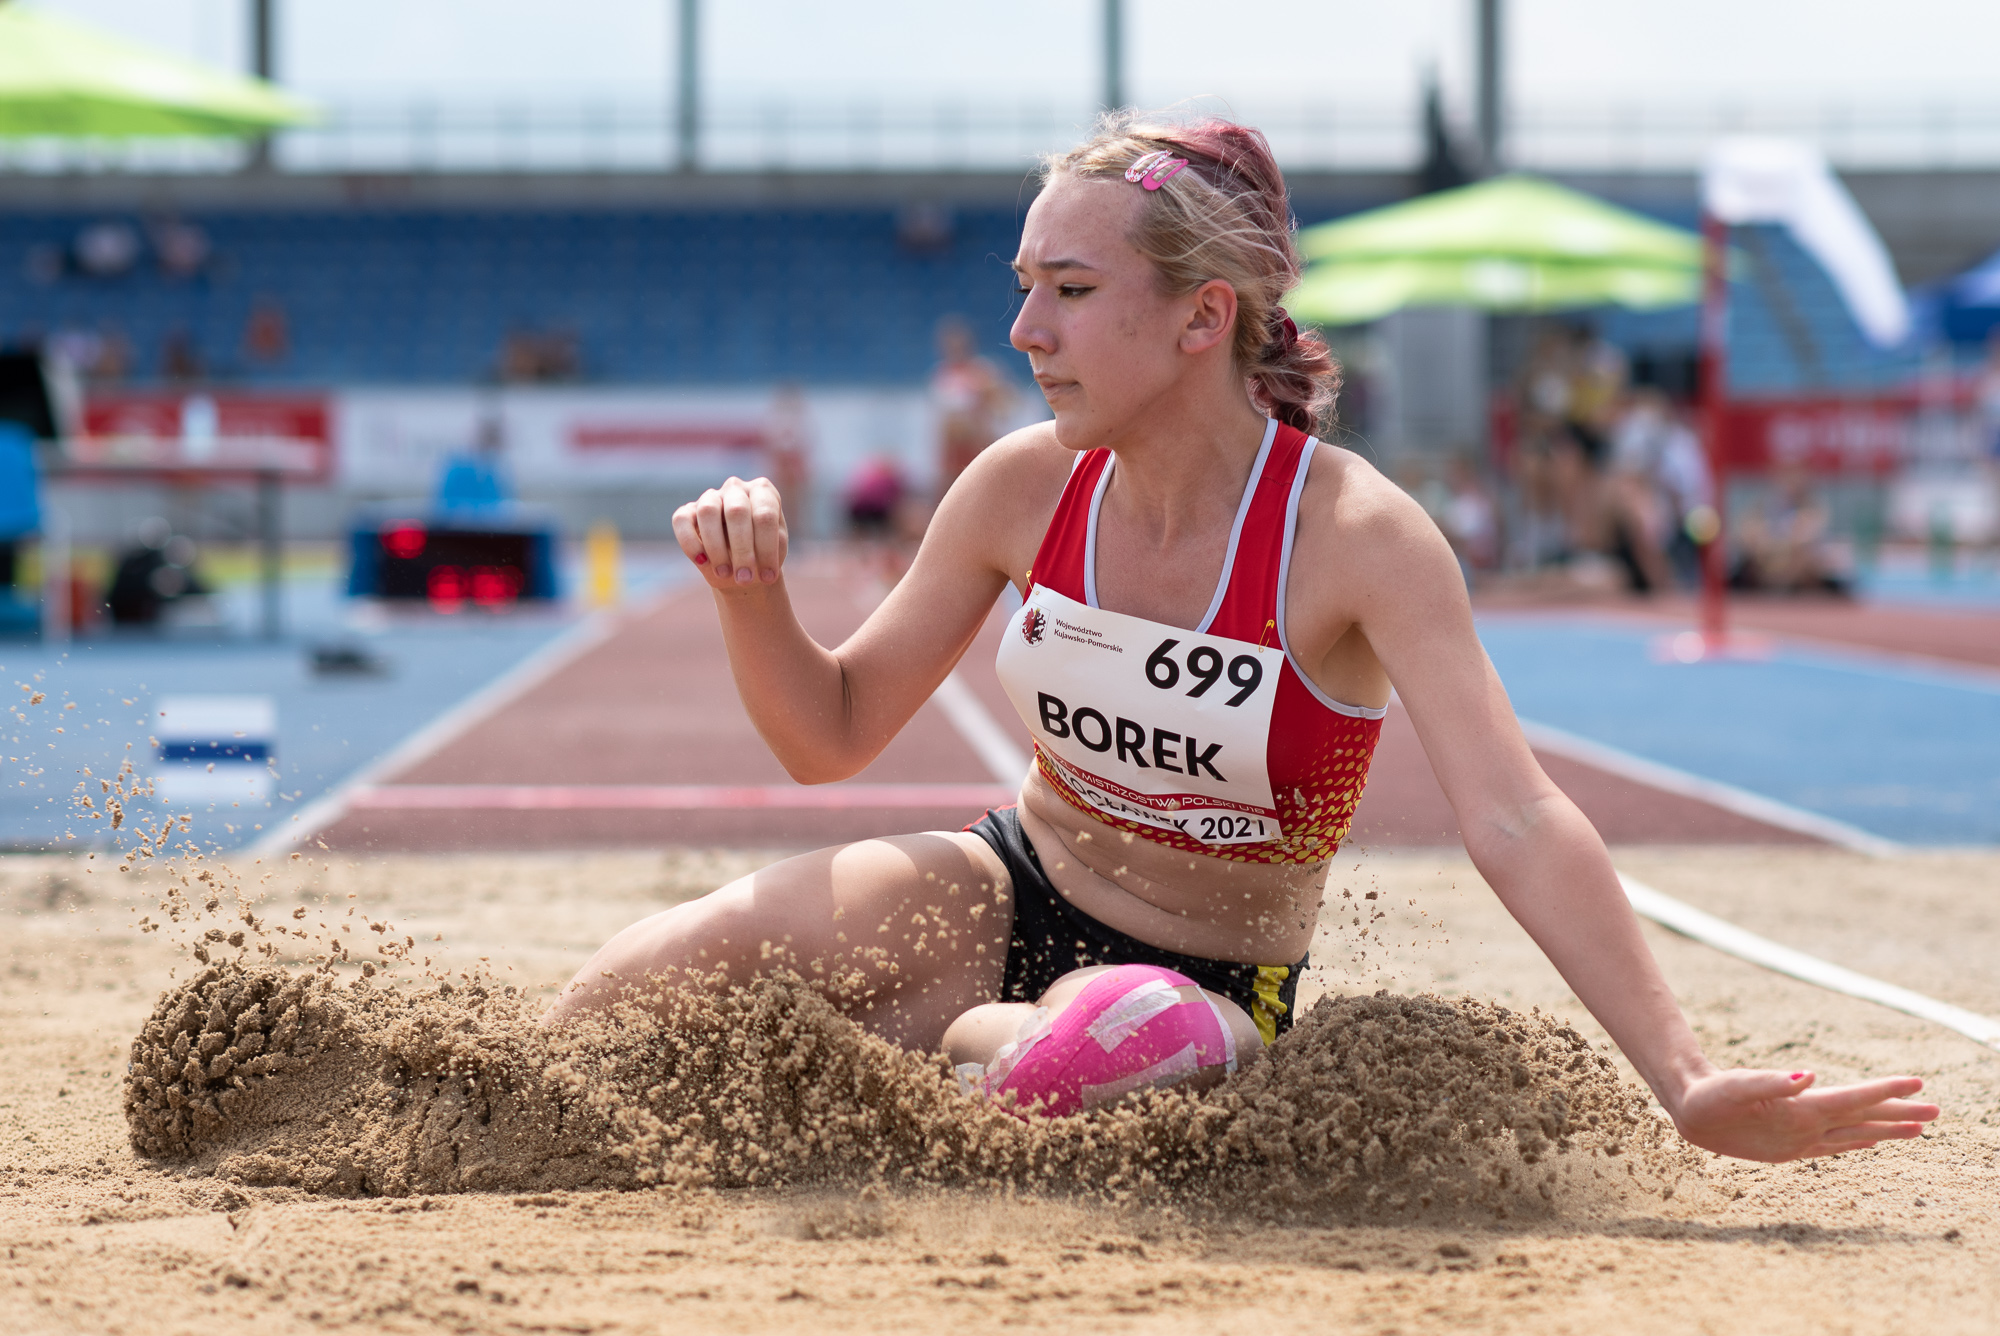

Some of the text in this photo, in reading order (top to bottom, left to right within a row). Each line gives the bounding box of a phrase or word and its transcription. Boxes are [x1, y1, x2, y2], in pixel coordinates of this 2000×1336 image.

[1053, 628, 1124, 654] Kujawsko-Pomorskie
[1055, 618, 1103, 638] Województwo
[1145, 638, 1264, 708] 699
[1037, 691, 1229, 783] BOREK
[1081, 772, 1178, 808] MISTRZOSTWA
[1182, 796, 1236, 810] POLSKI
[1238, 804, 1266, 815] U18
[1200, 815, 1265, 840] 2021
